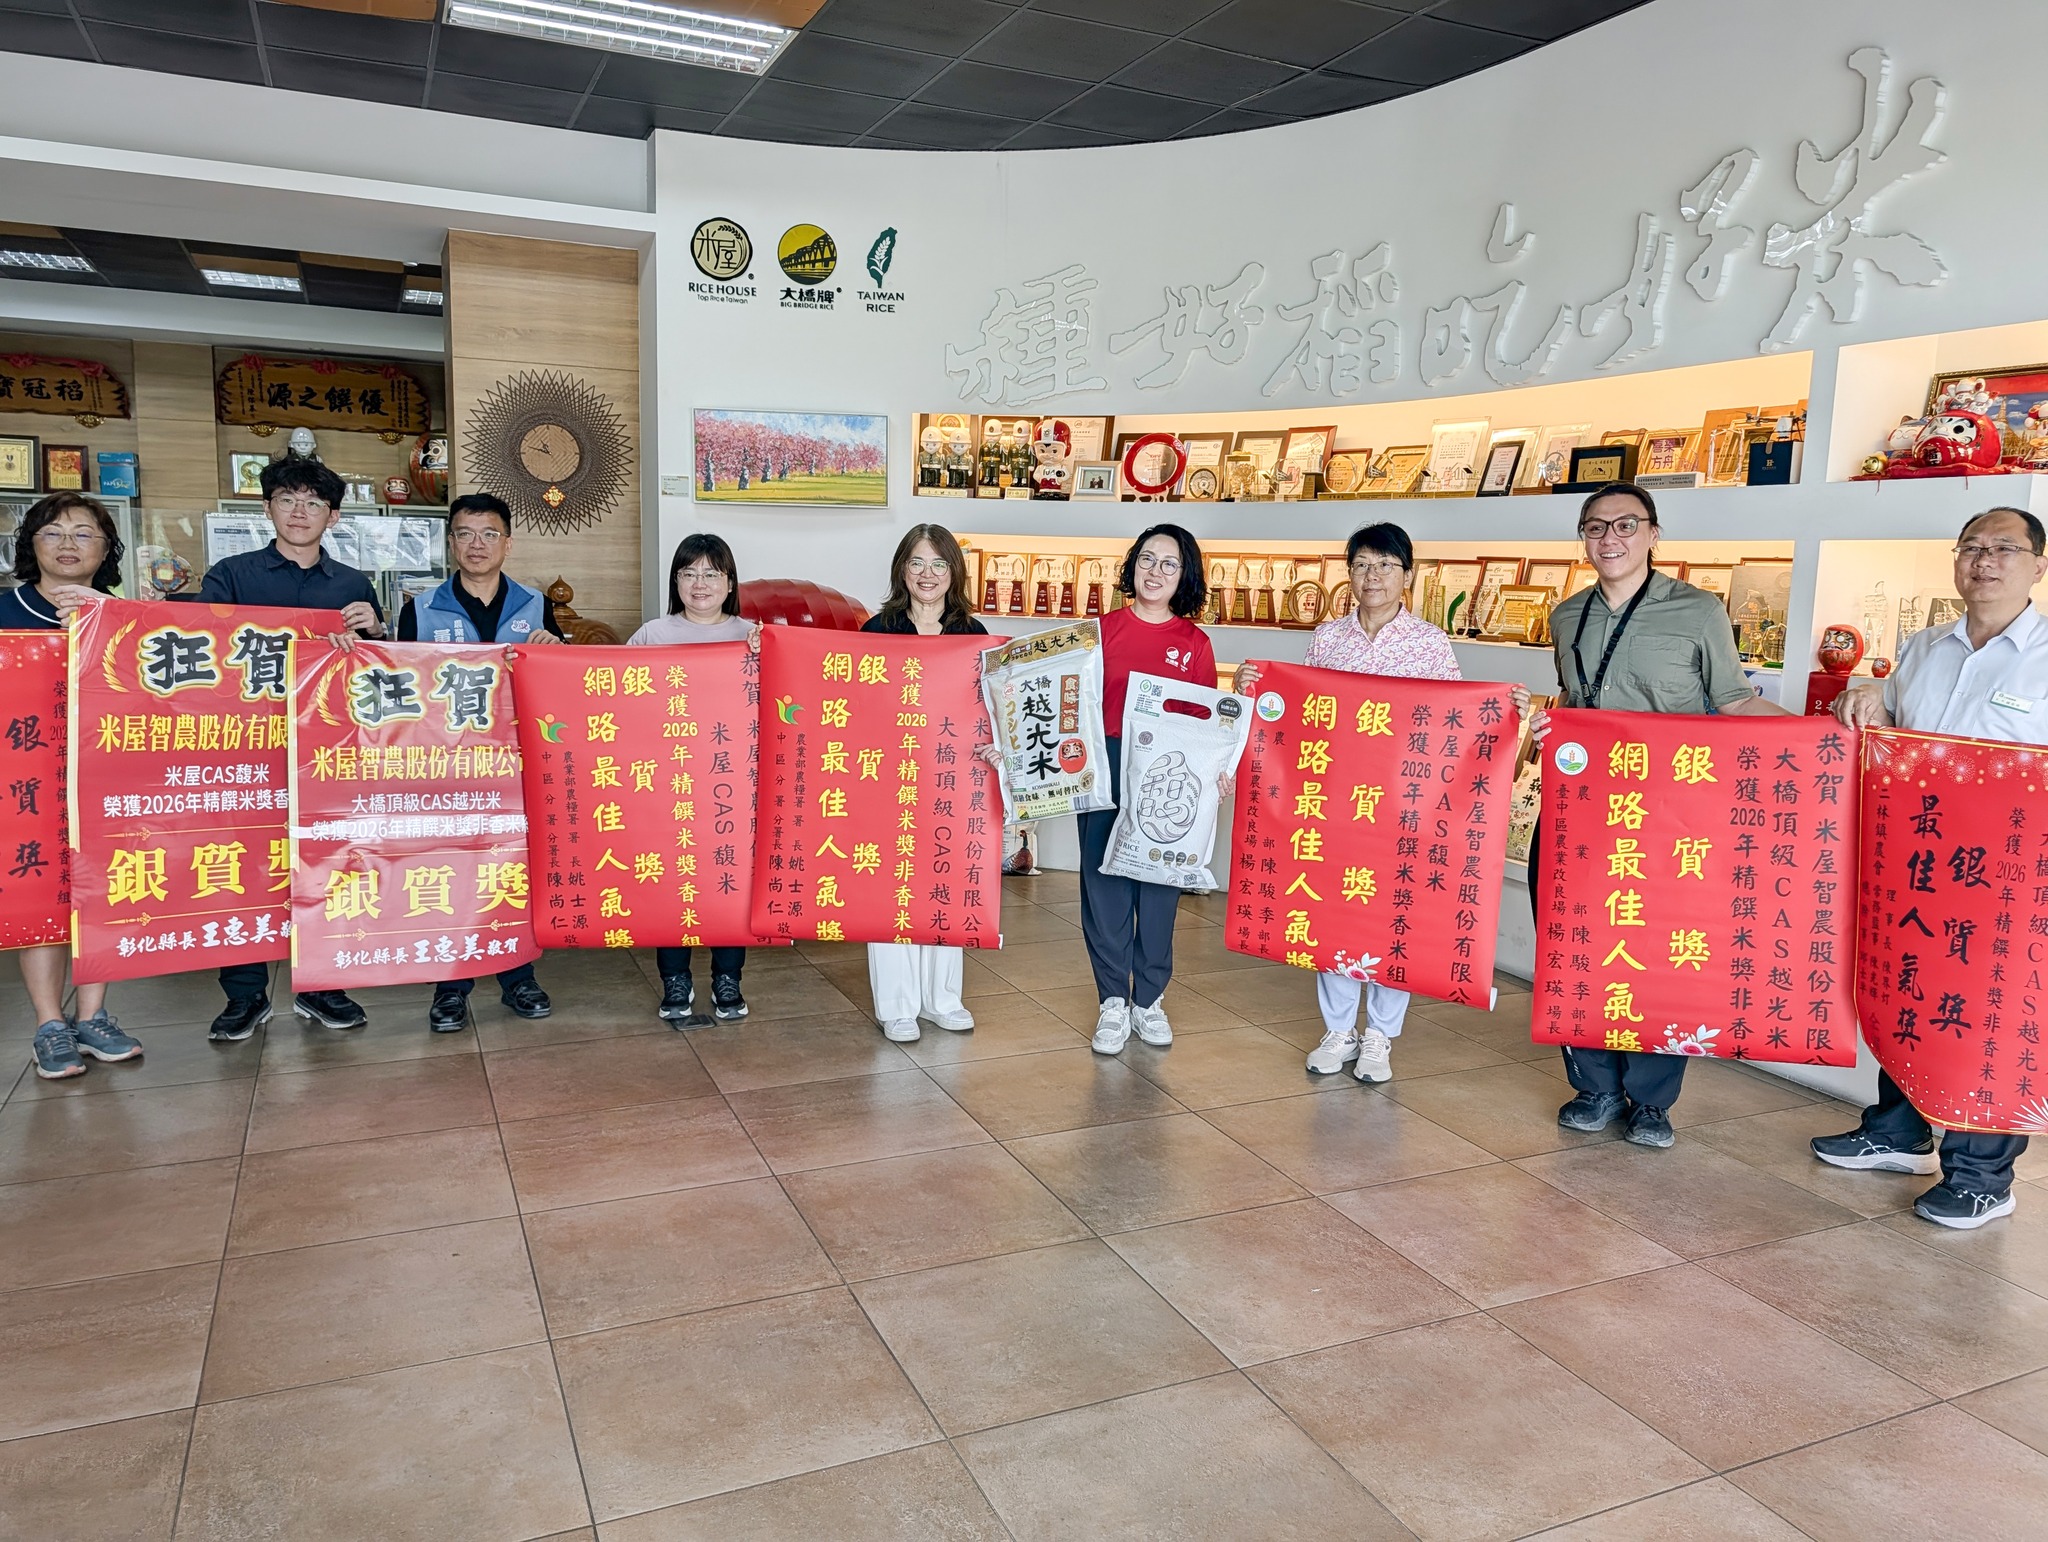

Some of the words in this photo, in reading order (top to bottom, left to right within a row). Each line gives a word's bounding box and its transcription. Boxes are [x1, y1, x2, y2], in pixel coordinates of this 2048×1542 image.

[689, 282, 714, 294] RICE
[716, 284, 757, 297] HOUSE
[697, 294, 709, 302] Top
[726, 296, 748, 304] Taiwan
[780, 287, 834, 304] 大橋牌
[780, 301, 793, 309] BIG
[793, 302, 818, 310] BRIDGE
[819, 303, 834, 311] RICE
[857, 290, 904, 301] TAIWAN
[866, 303, 895, 313] RICE
[147, 629, 293, 695] 狂賀
[1034, 632, 1080, 653] 越光米
[354, 663, 496, 728] 狂賀
[1019, 675, 1052, 693] 大橋
[96, 713, 288, 753] 米屋智農股份有限
[311, 744, 523, 782] 米屋智農股份有限公
[852, 653, 891, 876] 銀質獎
[1021, 694, 1062, 780] 越光米
[1472, 696, 1503, 762] 恭賀
[5, 715, 49, 878] 銀質獎
[50, 680, 71, 905] 榮獲202年精饌米獎香米組
[104, 789, 288, 818] 榮獲2026年精饌米獎香
[164, 763, 270, 787] 米屋CAS馥米
[351, 790, 502, 814] 大橋頂級CAS越光米
[621, 665, 666, 884] 銀質獎
[815, 651, 853, 942] 網路最佳人氣獎
[1340, 698, 1395, 905] 銀質獎
[1425, 707, 1465, 893] 米屋CAS馥米
[1812, 732, 1847, 805] 恭賀
[582, 666, 635, 948] 網路最佳人氣獎
[709, 721, 740, 895] 米屋CAS馥米
[1873, 788, 1891, 876] 二林鎮農會
[1123, 842, 1140, 852] RICE
[1386, 704, 1433, 985] 榮獲2026年精饌米獎香米組
[1668, 743, 1719, 971] 銀質獎
[324, 862, 530, 922] 銀質獎
[1601, 740, 1651, 1052] 網路最佳人氣獎
[1765, 747, 1802, 1050] 大橋頂級CAS越光米
[1892, 795, 1943, 1051] 最佳人氣獎
[1929, 845, 1991, 1039] 銀質獎
[1976, 807, 2027, 1105] 榮獲2026年精饌米獎非香米組
